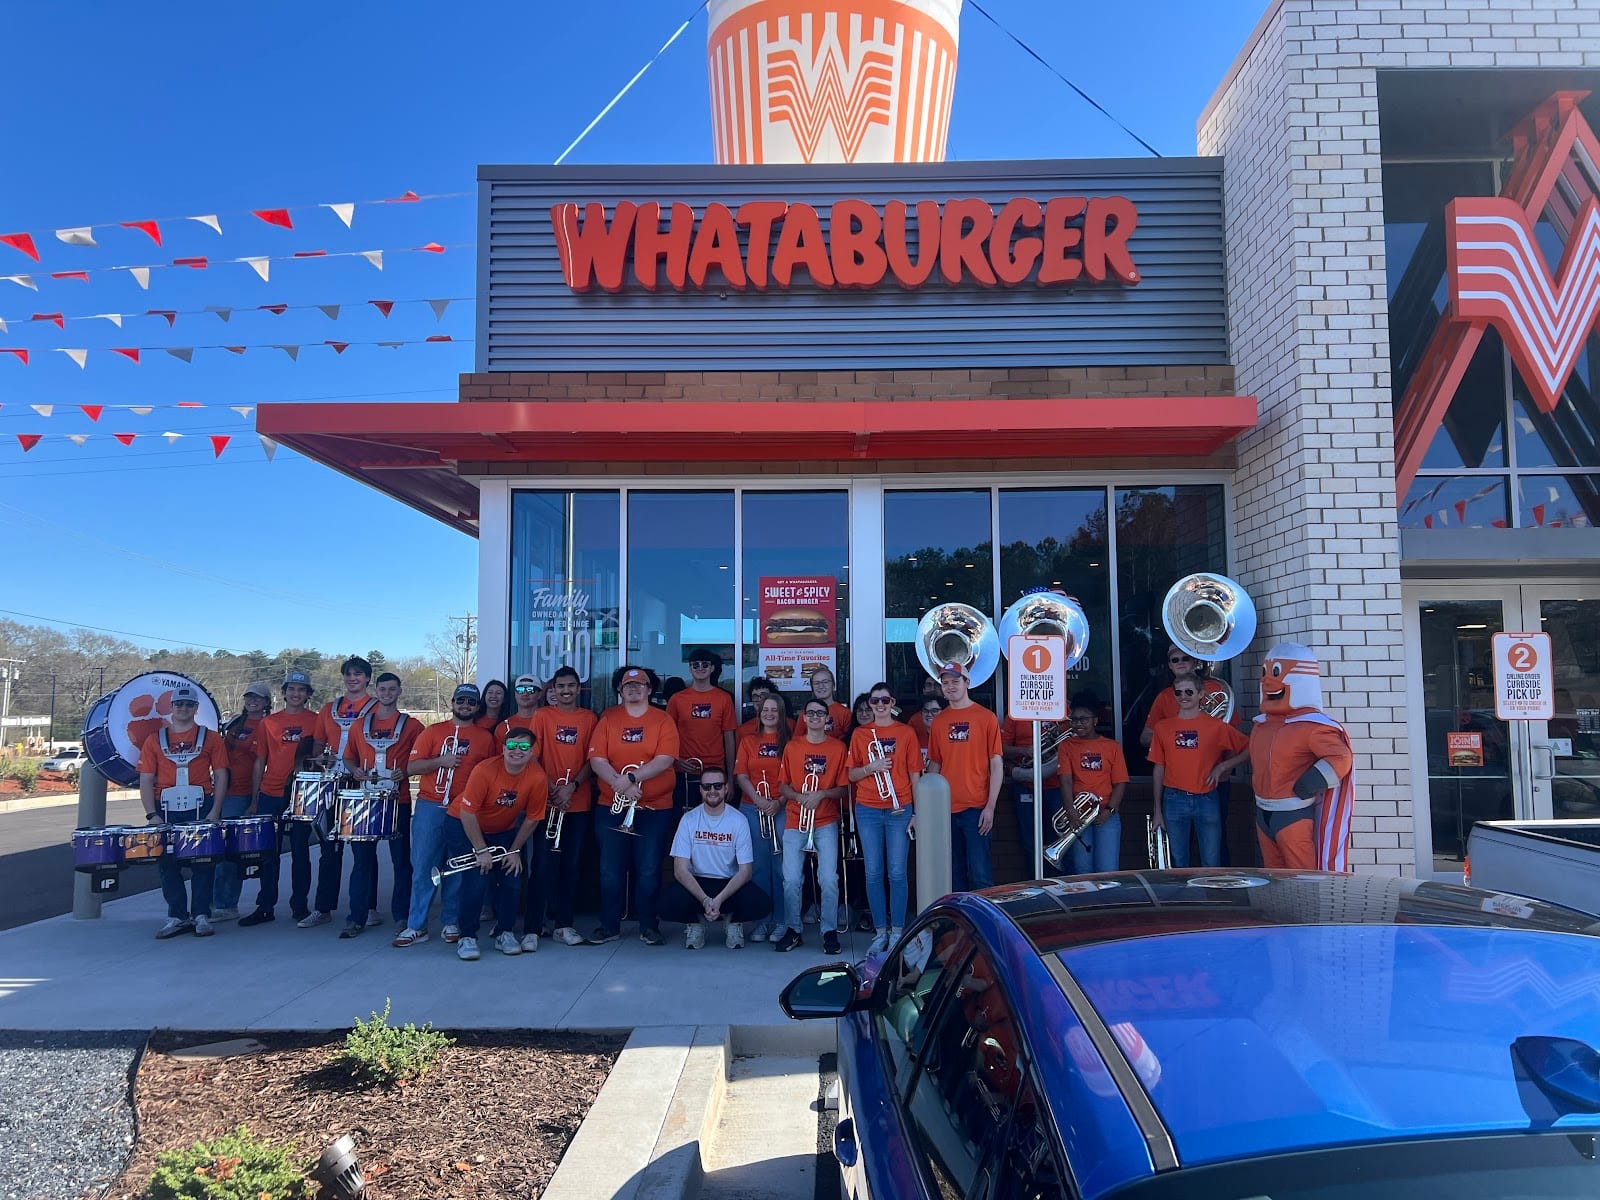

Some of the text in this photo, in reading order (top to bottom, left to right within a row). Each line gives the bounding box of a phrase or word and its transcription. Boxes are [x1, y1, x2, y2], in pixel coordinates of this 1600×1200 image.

[550, 195, 1141, 294] WHATABURGER
[764, 586, 796, 598] SWEET
[803, 586, 830, 598] SPICY
[532, 587, 590, 617] Family
[531, 610, 557, 618] OWNED
[797, 654, 830, 662] Favorites
[1031, 649, 1042, 669] 1
[1514, 647, 1531, 668] 2
[1020, 680, 1054, 690] CURBSIDE
[1506, 679, 1541, 689] CURBSIDE
[1020, 689, 1054, 701] PICK UP
[1507, 688, 1542, 700] PICK UP
